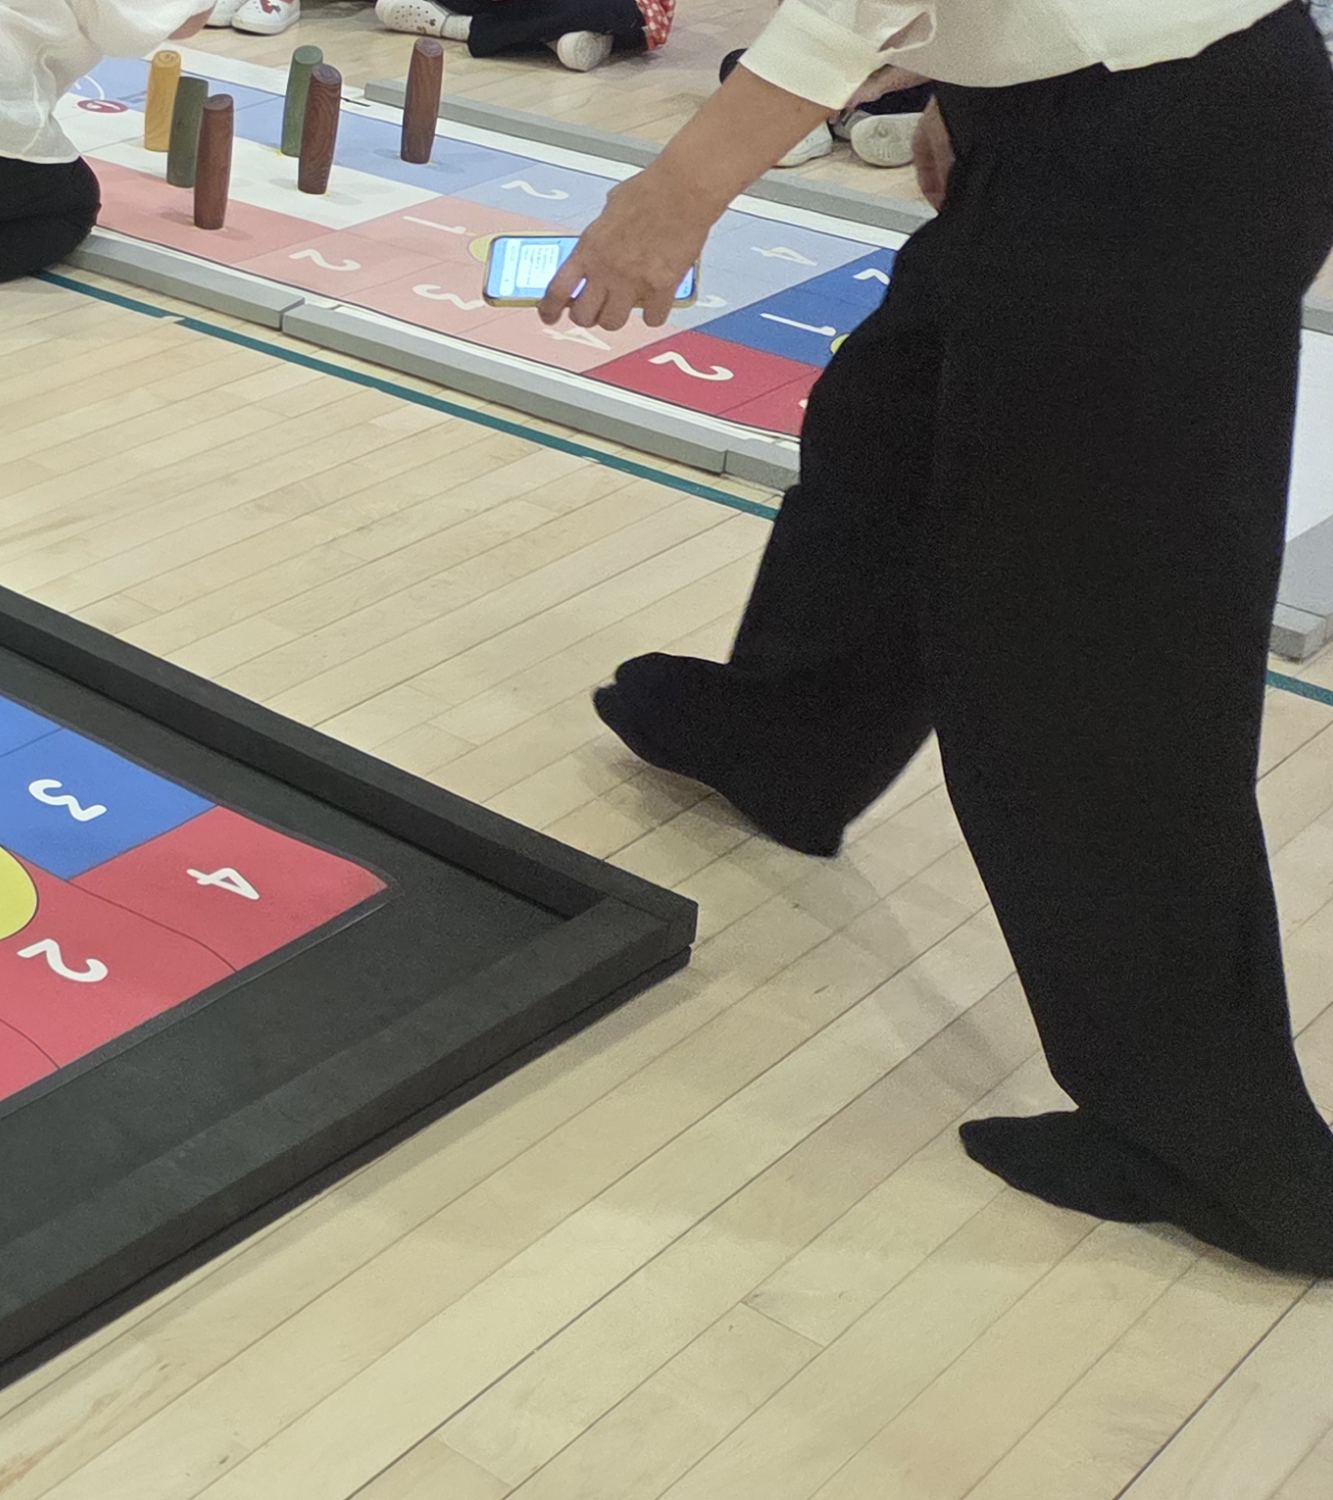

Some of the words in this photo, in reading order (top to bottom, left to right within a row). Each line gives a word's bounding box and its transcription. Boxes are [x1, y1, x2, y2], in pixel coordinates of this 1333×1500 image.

[500, 179, 570, 200] 2
[402, 215, 467, 235] 1
[288, 248, 362, 272] 2
[412, 283, 484, 311] 3
[759, 312, 837, 337] 1
[648, 351, 734, 381] 2
[28, 778, 107, 822] 3
[186, 867, 260, 900] 4
[16, 938, 109, 983] 2
